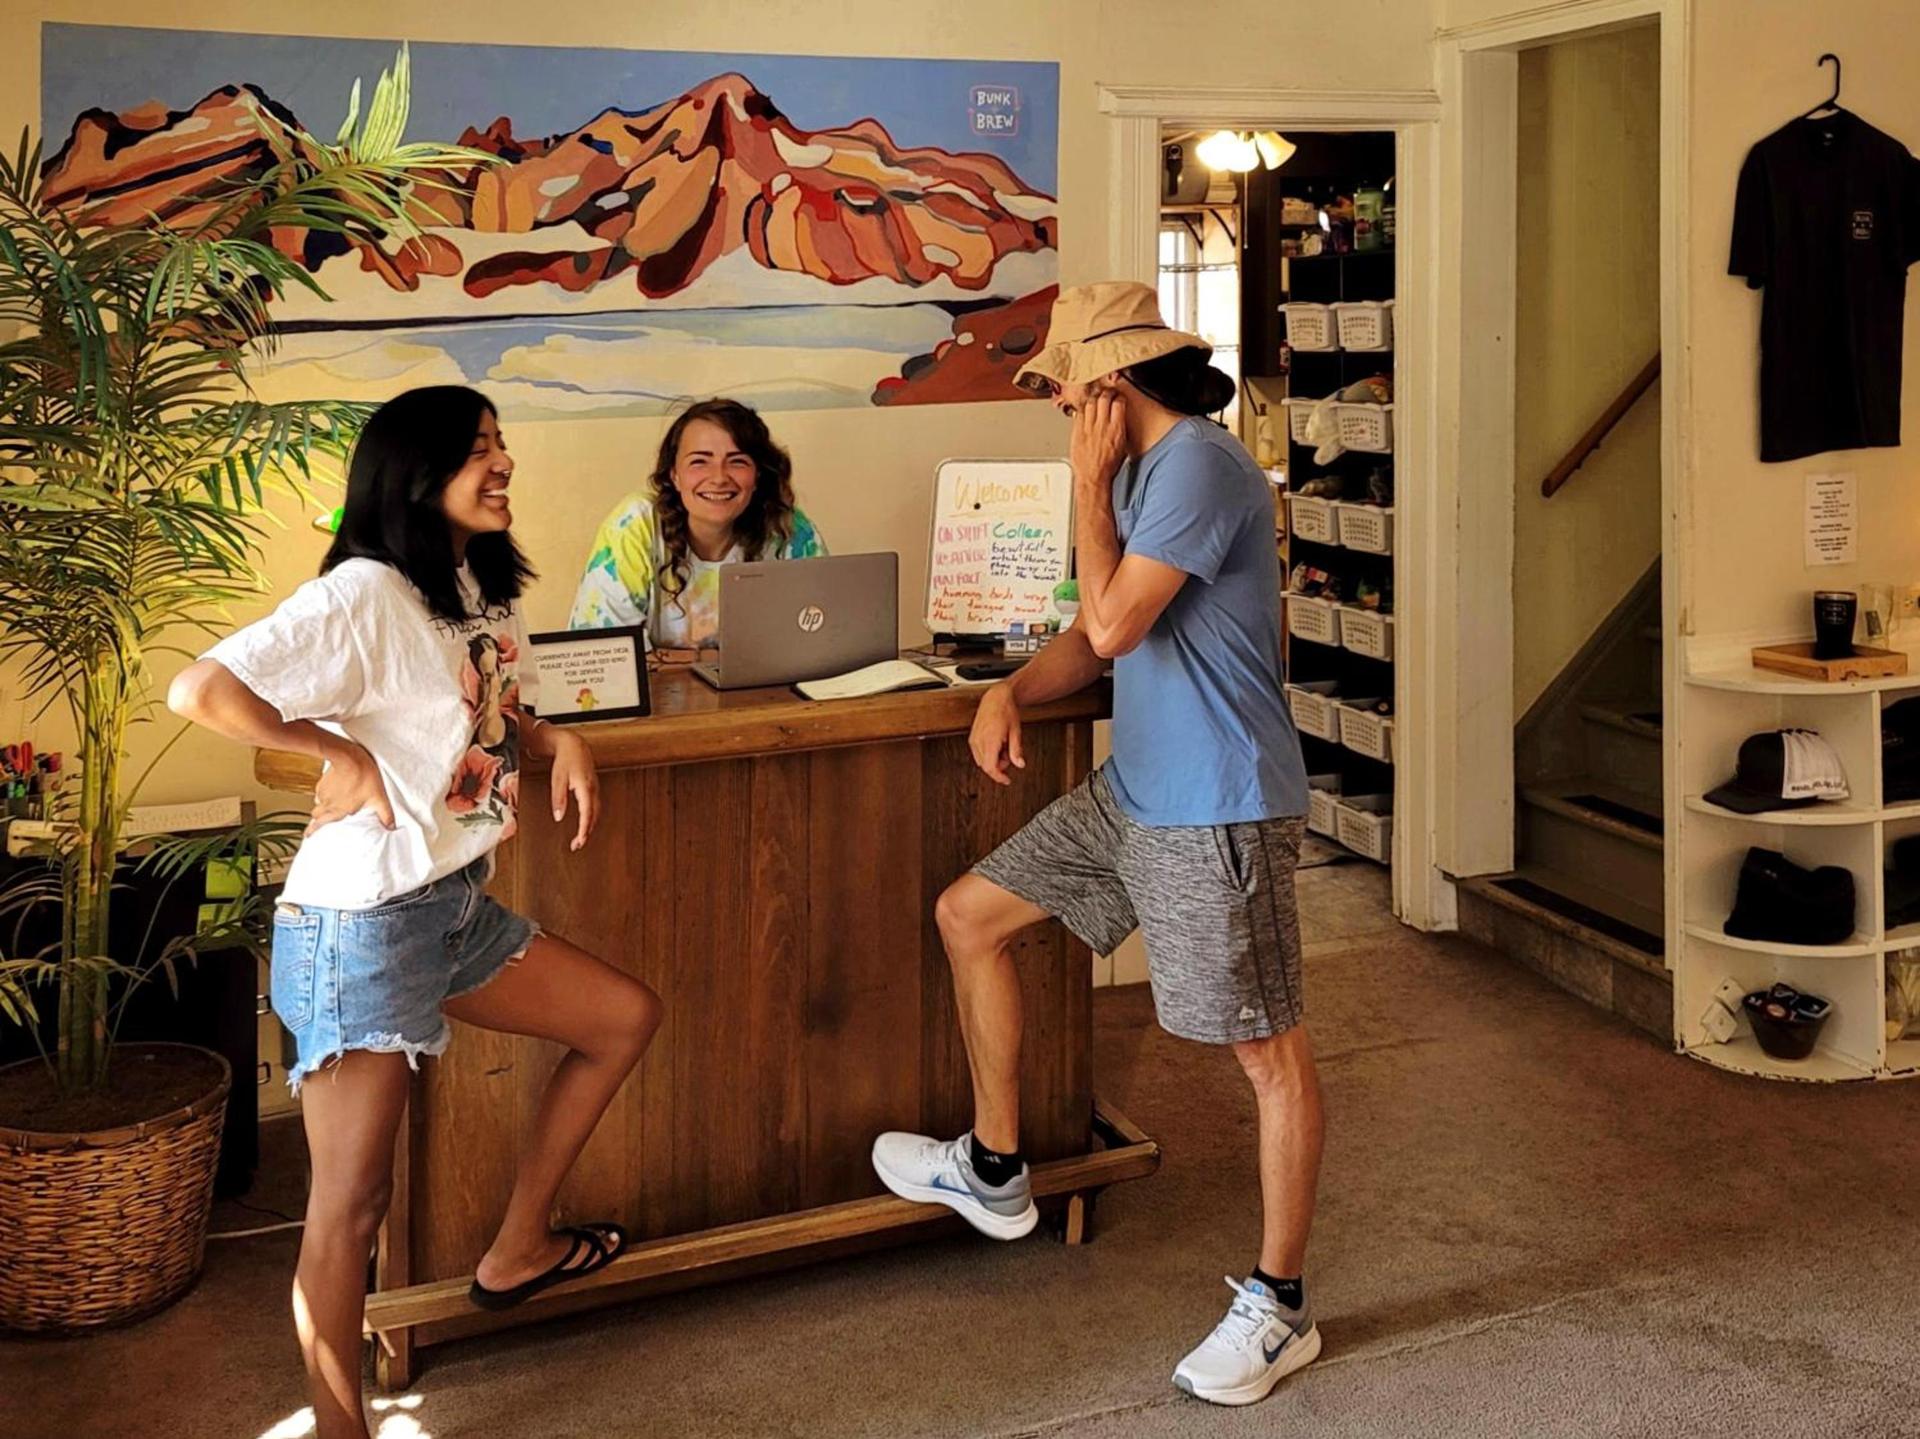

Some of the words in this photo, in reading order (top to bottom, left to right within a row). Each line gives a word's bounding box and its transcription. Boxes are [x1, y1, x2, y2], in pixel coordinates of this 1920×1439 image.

[977, 91, 1011, 106] BUNK
[977, 113, 1014, 129] BREW
[954, 474, 1051, 510] Welcome!
[993, 522, 1053, 539] Colleen
[801, 606, 821, 632] hp
[539, 662, 563, 670] PLEASE
[564, 660, 580, 668] CALL
[564, 669, 577, 677] FOR
